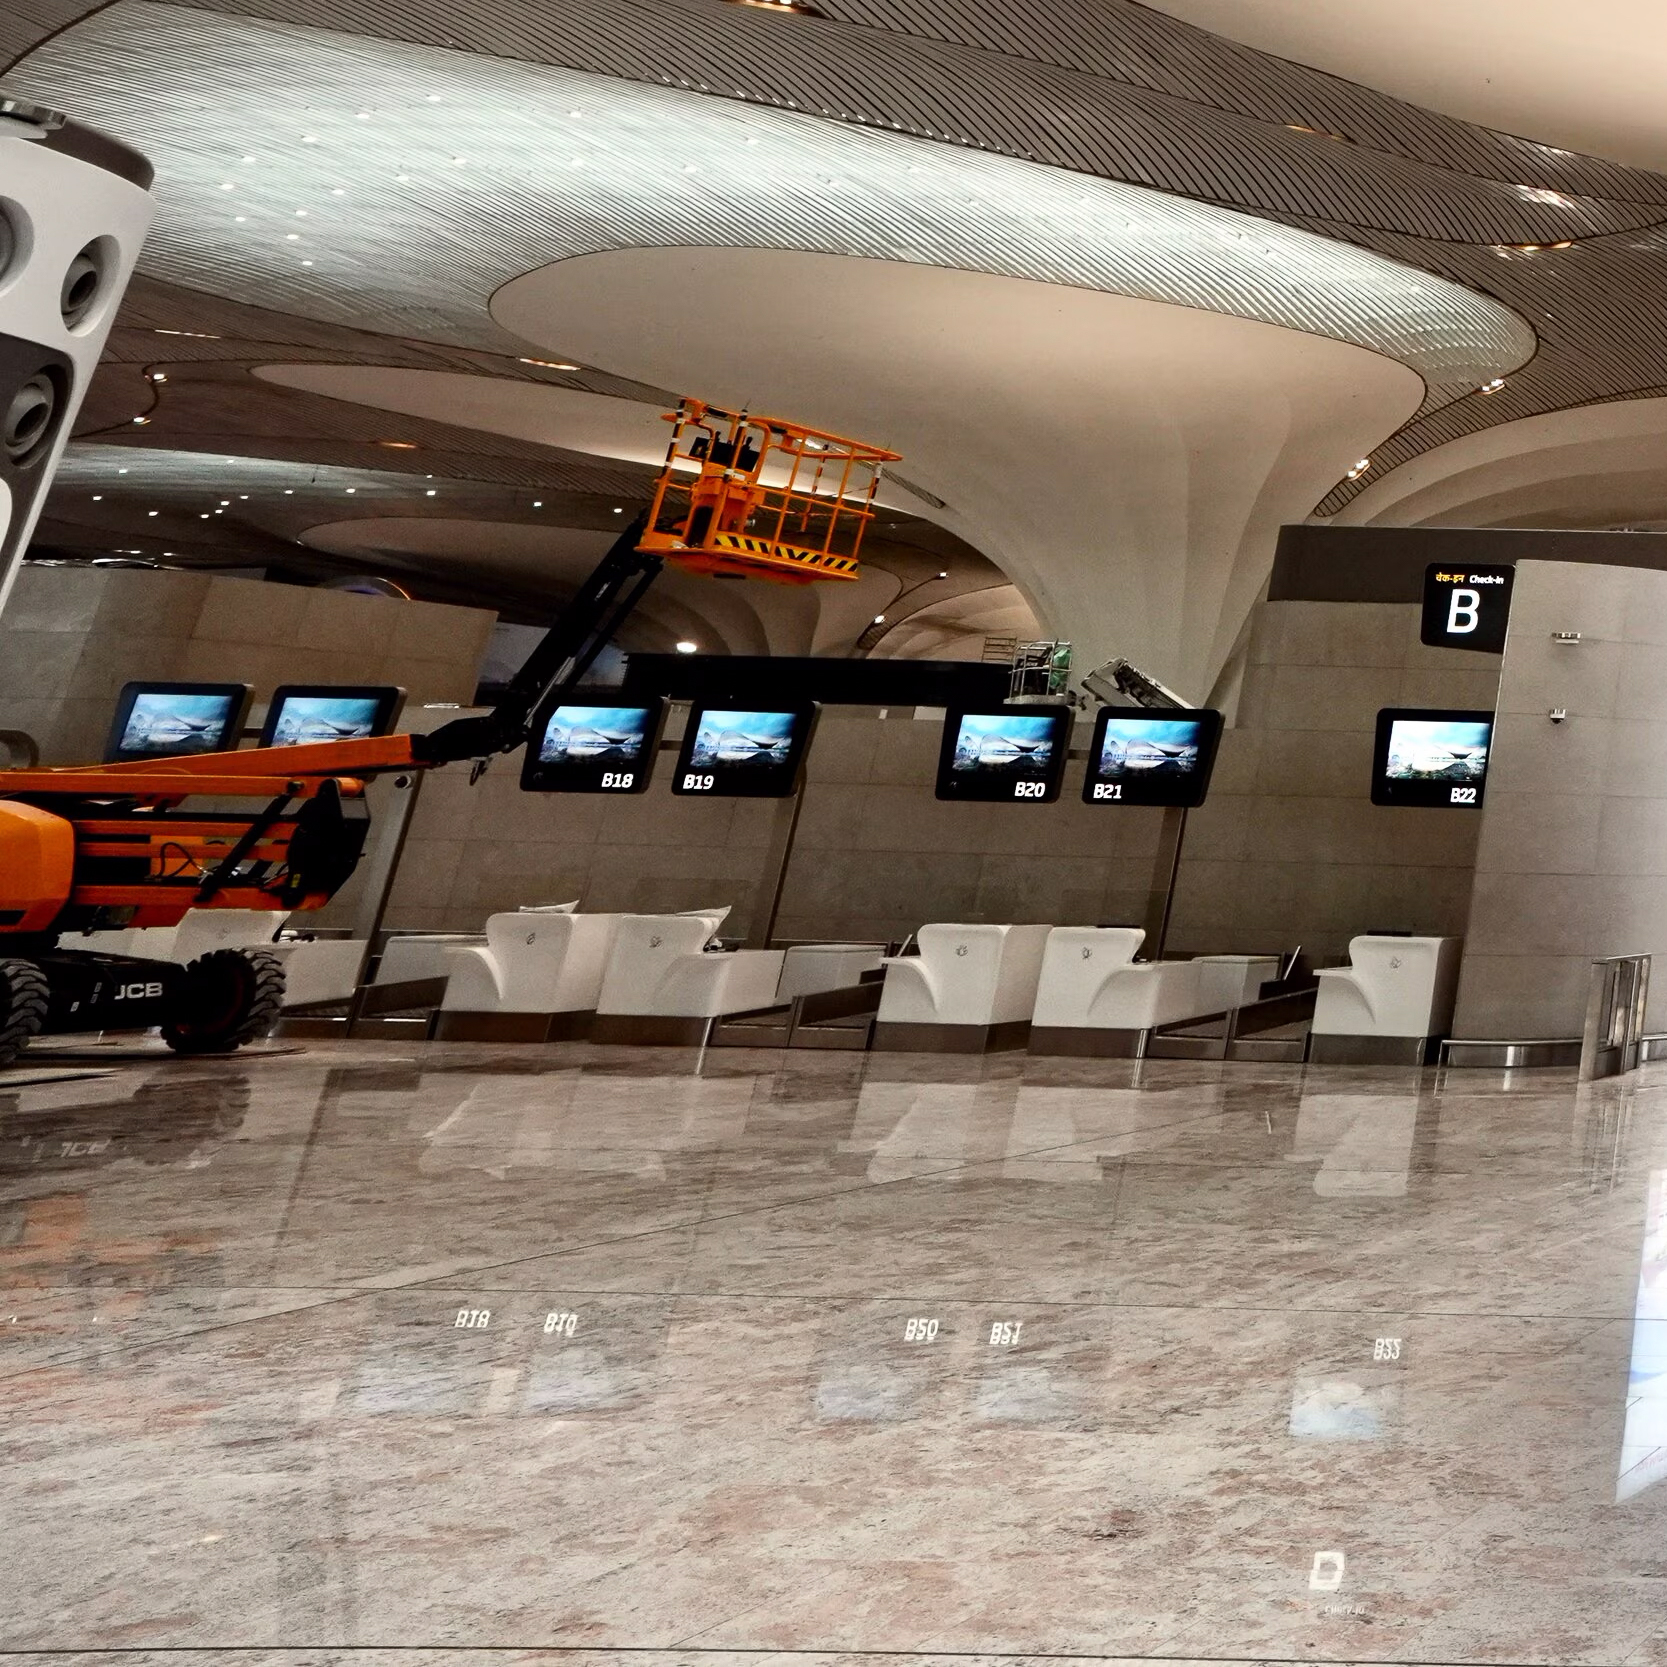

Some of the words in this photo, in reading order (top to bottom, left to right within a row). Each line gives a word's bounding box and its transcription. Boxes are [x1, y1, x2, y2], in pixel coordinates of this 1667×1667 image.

[1469, 575, 1504, 584] Check-in
[1447, 589, 1480, 633] B
[601, 772, 634, 788] B18
[682, 774, 714, 790] B19
[1014, 781, 1046, 797] B20
[1093, 783, 1122, 799] B21
[1450, 787, 1476, 803] B22
[114, 982, 163, 1000] JCB
